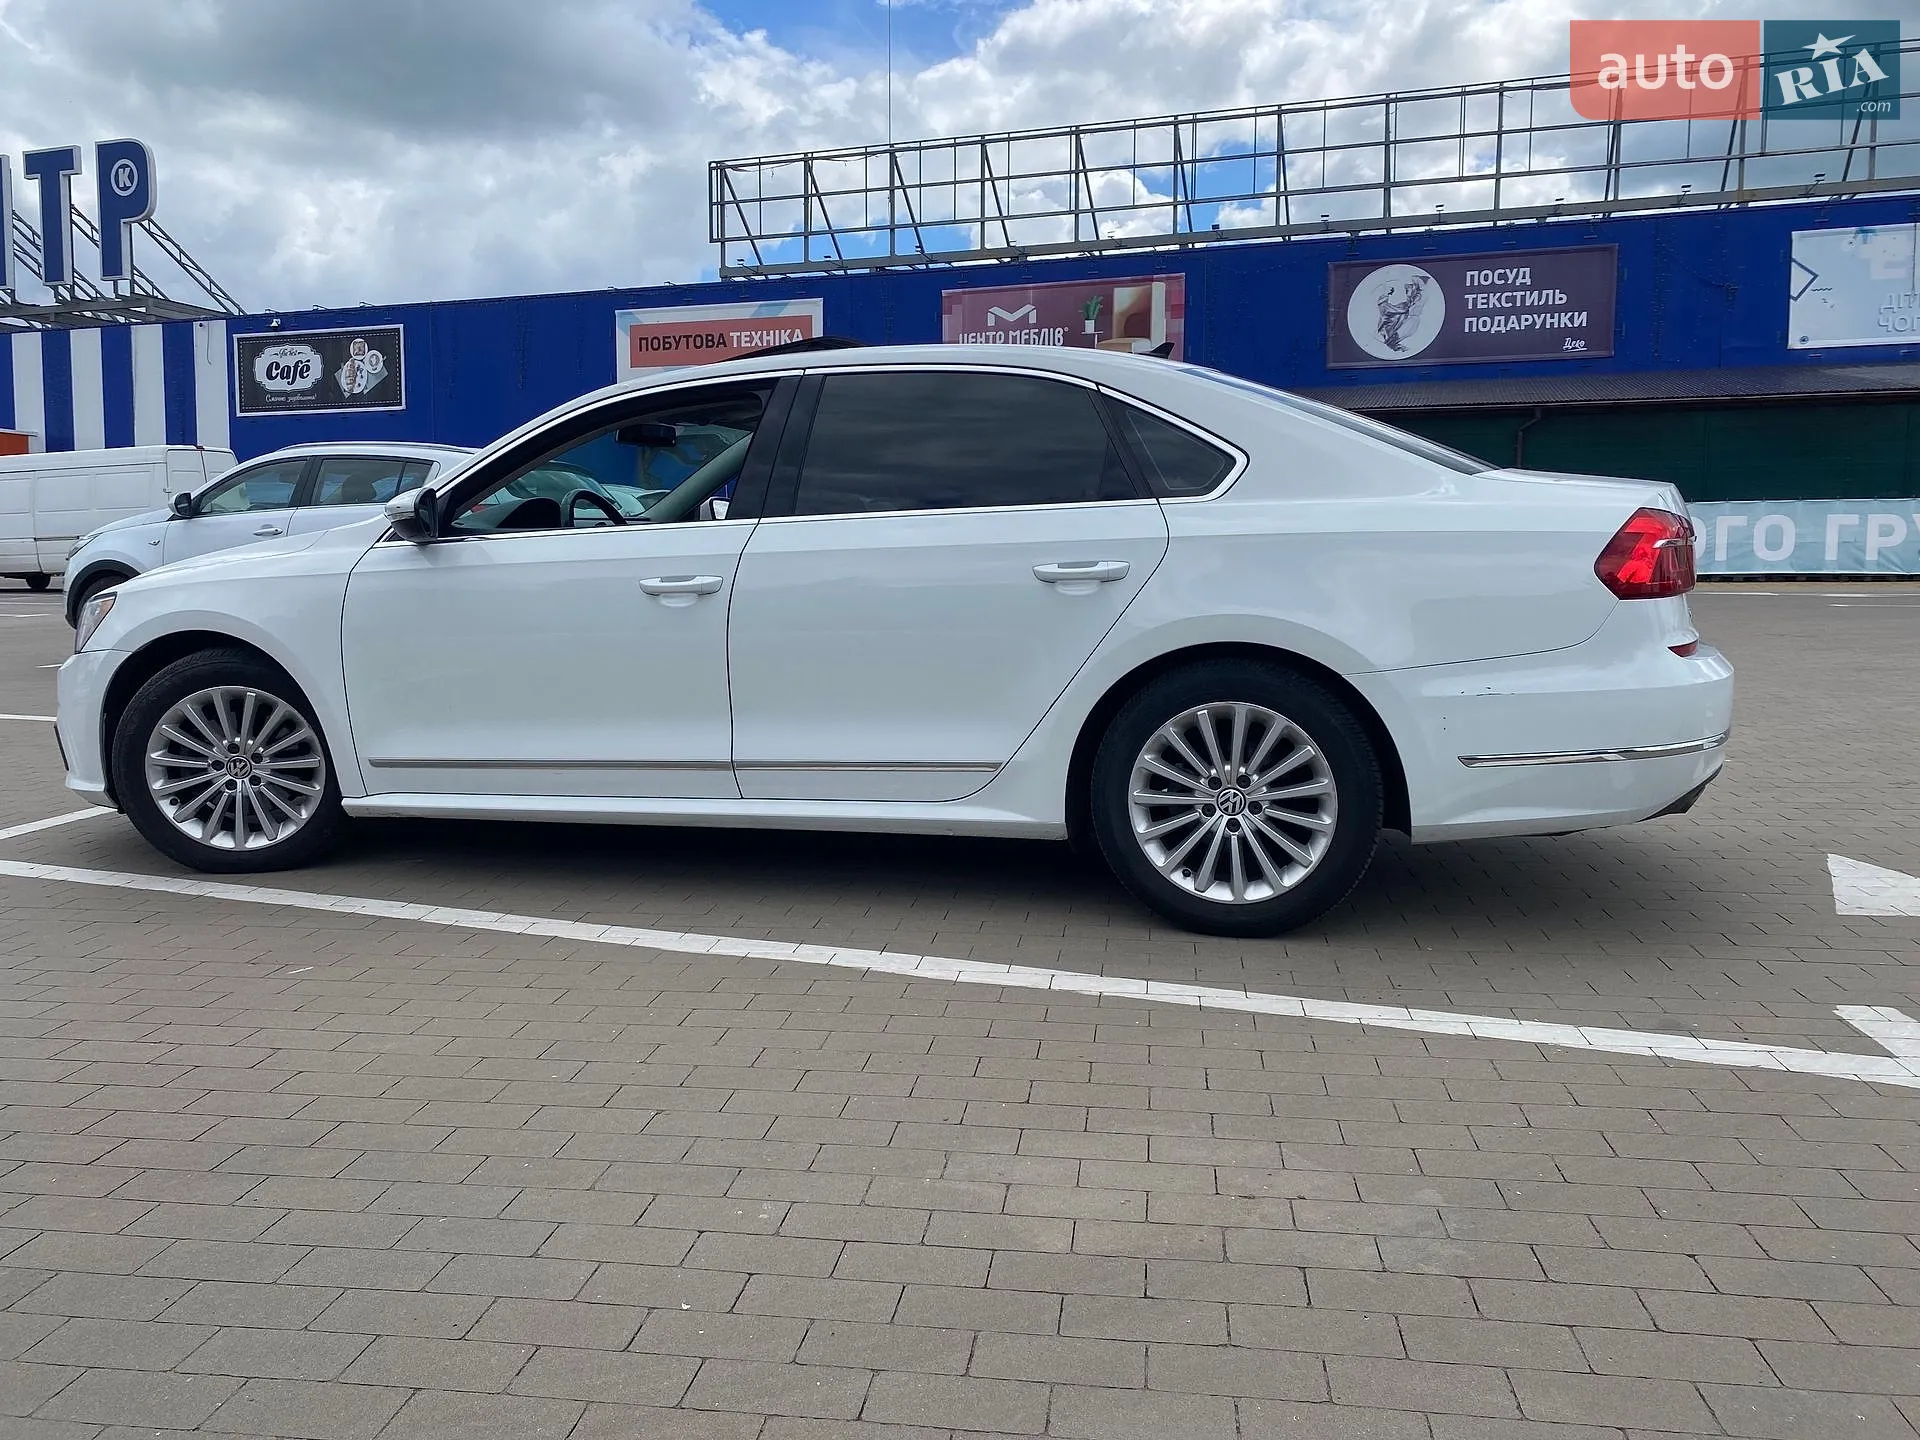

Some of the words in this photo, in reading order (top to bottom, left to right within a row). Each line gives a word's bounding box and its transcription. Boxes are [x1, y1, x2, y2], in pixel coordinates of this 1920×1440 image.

[1465, 267, 1531, 287] ПОСУД
[1465, 289, 1567, 310] ТЕКСТИЛЬ
[1464, 311, 1588, 334] ПОДАРУНКИ
[638, 333, 727, 353] ПОБУТОВА
[730, 328, 803, 348] ТЕХНІКА
[266, 359, 311, 385] Café
[1824, 513, 1920, 561] ГР
